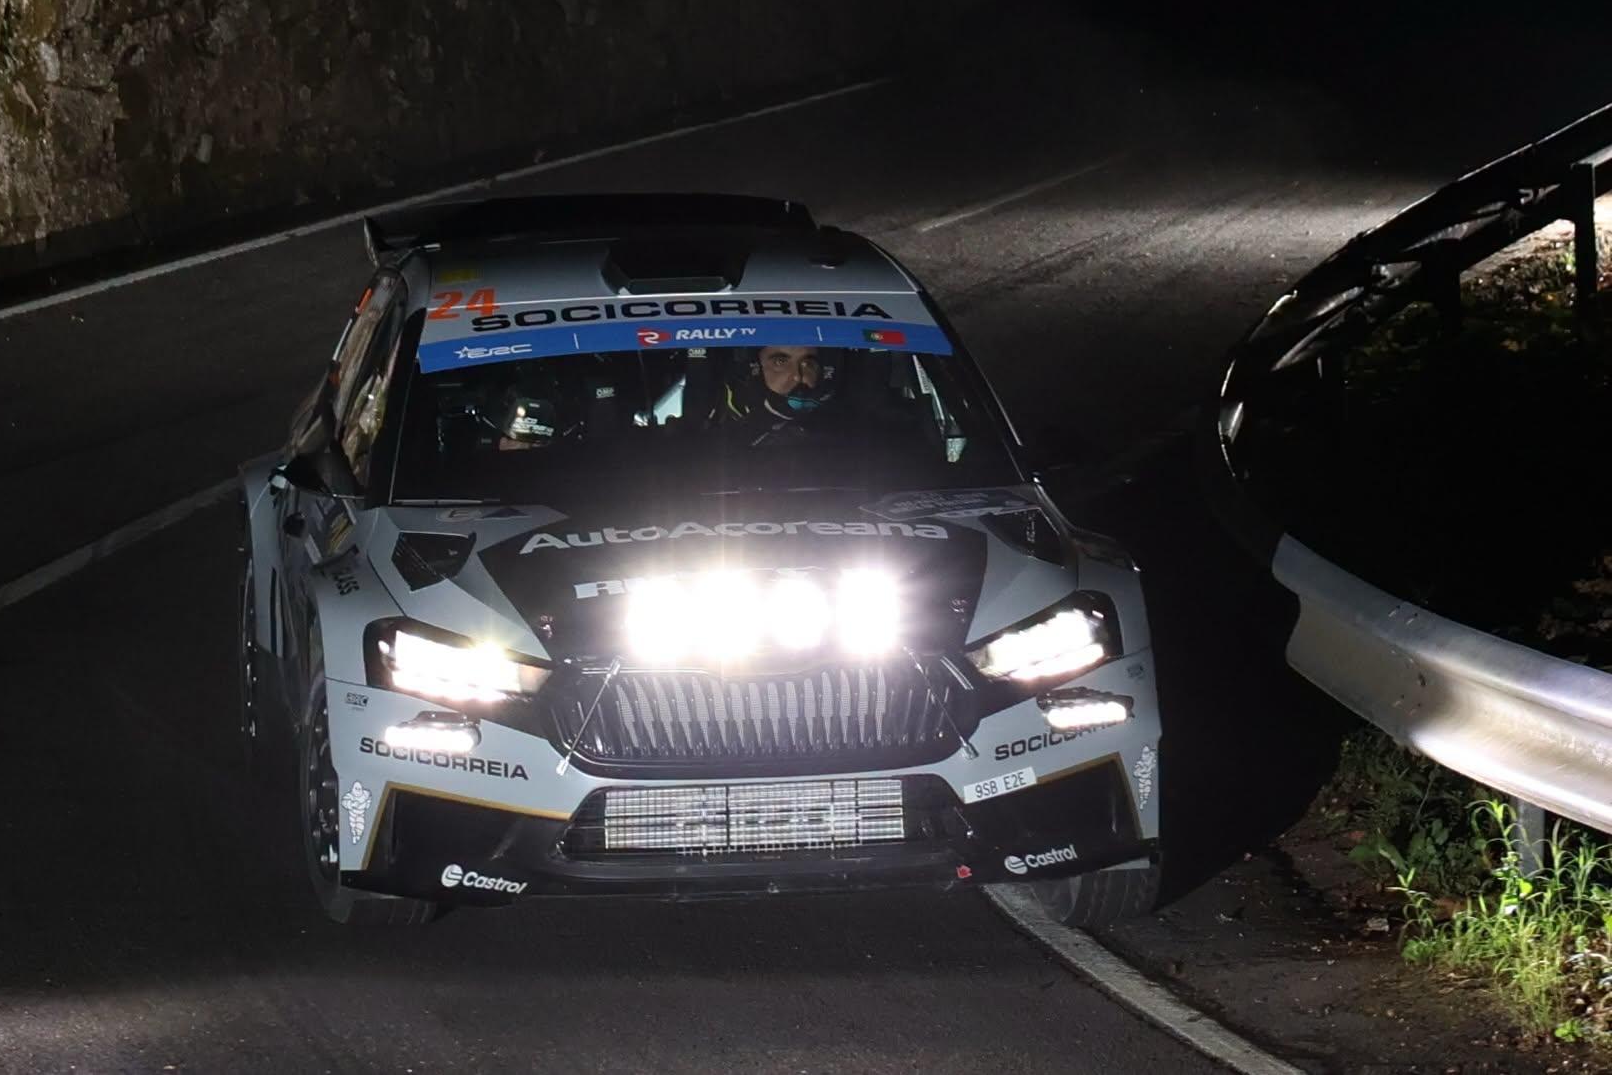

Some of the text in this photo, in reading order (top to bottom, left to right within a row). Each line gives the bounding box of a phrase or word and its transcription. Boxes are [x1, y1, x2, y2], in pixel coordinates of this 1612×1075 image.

[426, 288, 501, 321] 24
[472, 299, 893, 332] SOCICORREIA
[675, 327, 737, 341] RALLY
[737, 327, 756, 336] TV
[467, 343, 533, 359] ERC
[519, 521, 949, 555] AutoAçoreana
[359, 736, 529, 781] SOCICORREIA
[1025, 844, 1079, 869] Castrol
[462, 871, 528, 895] Castrol
